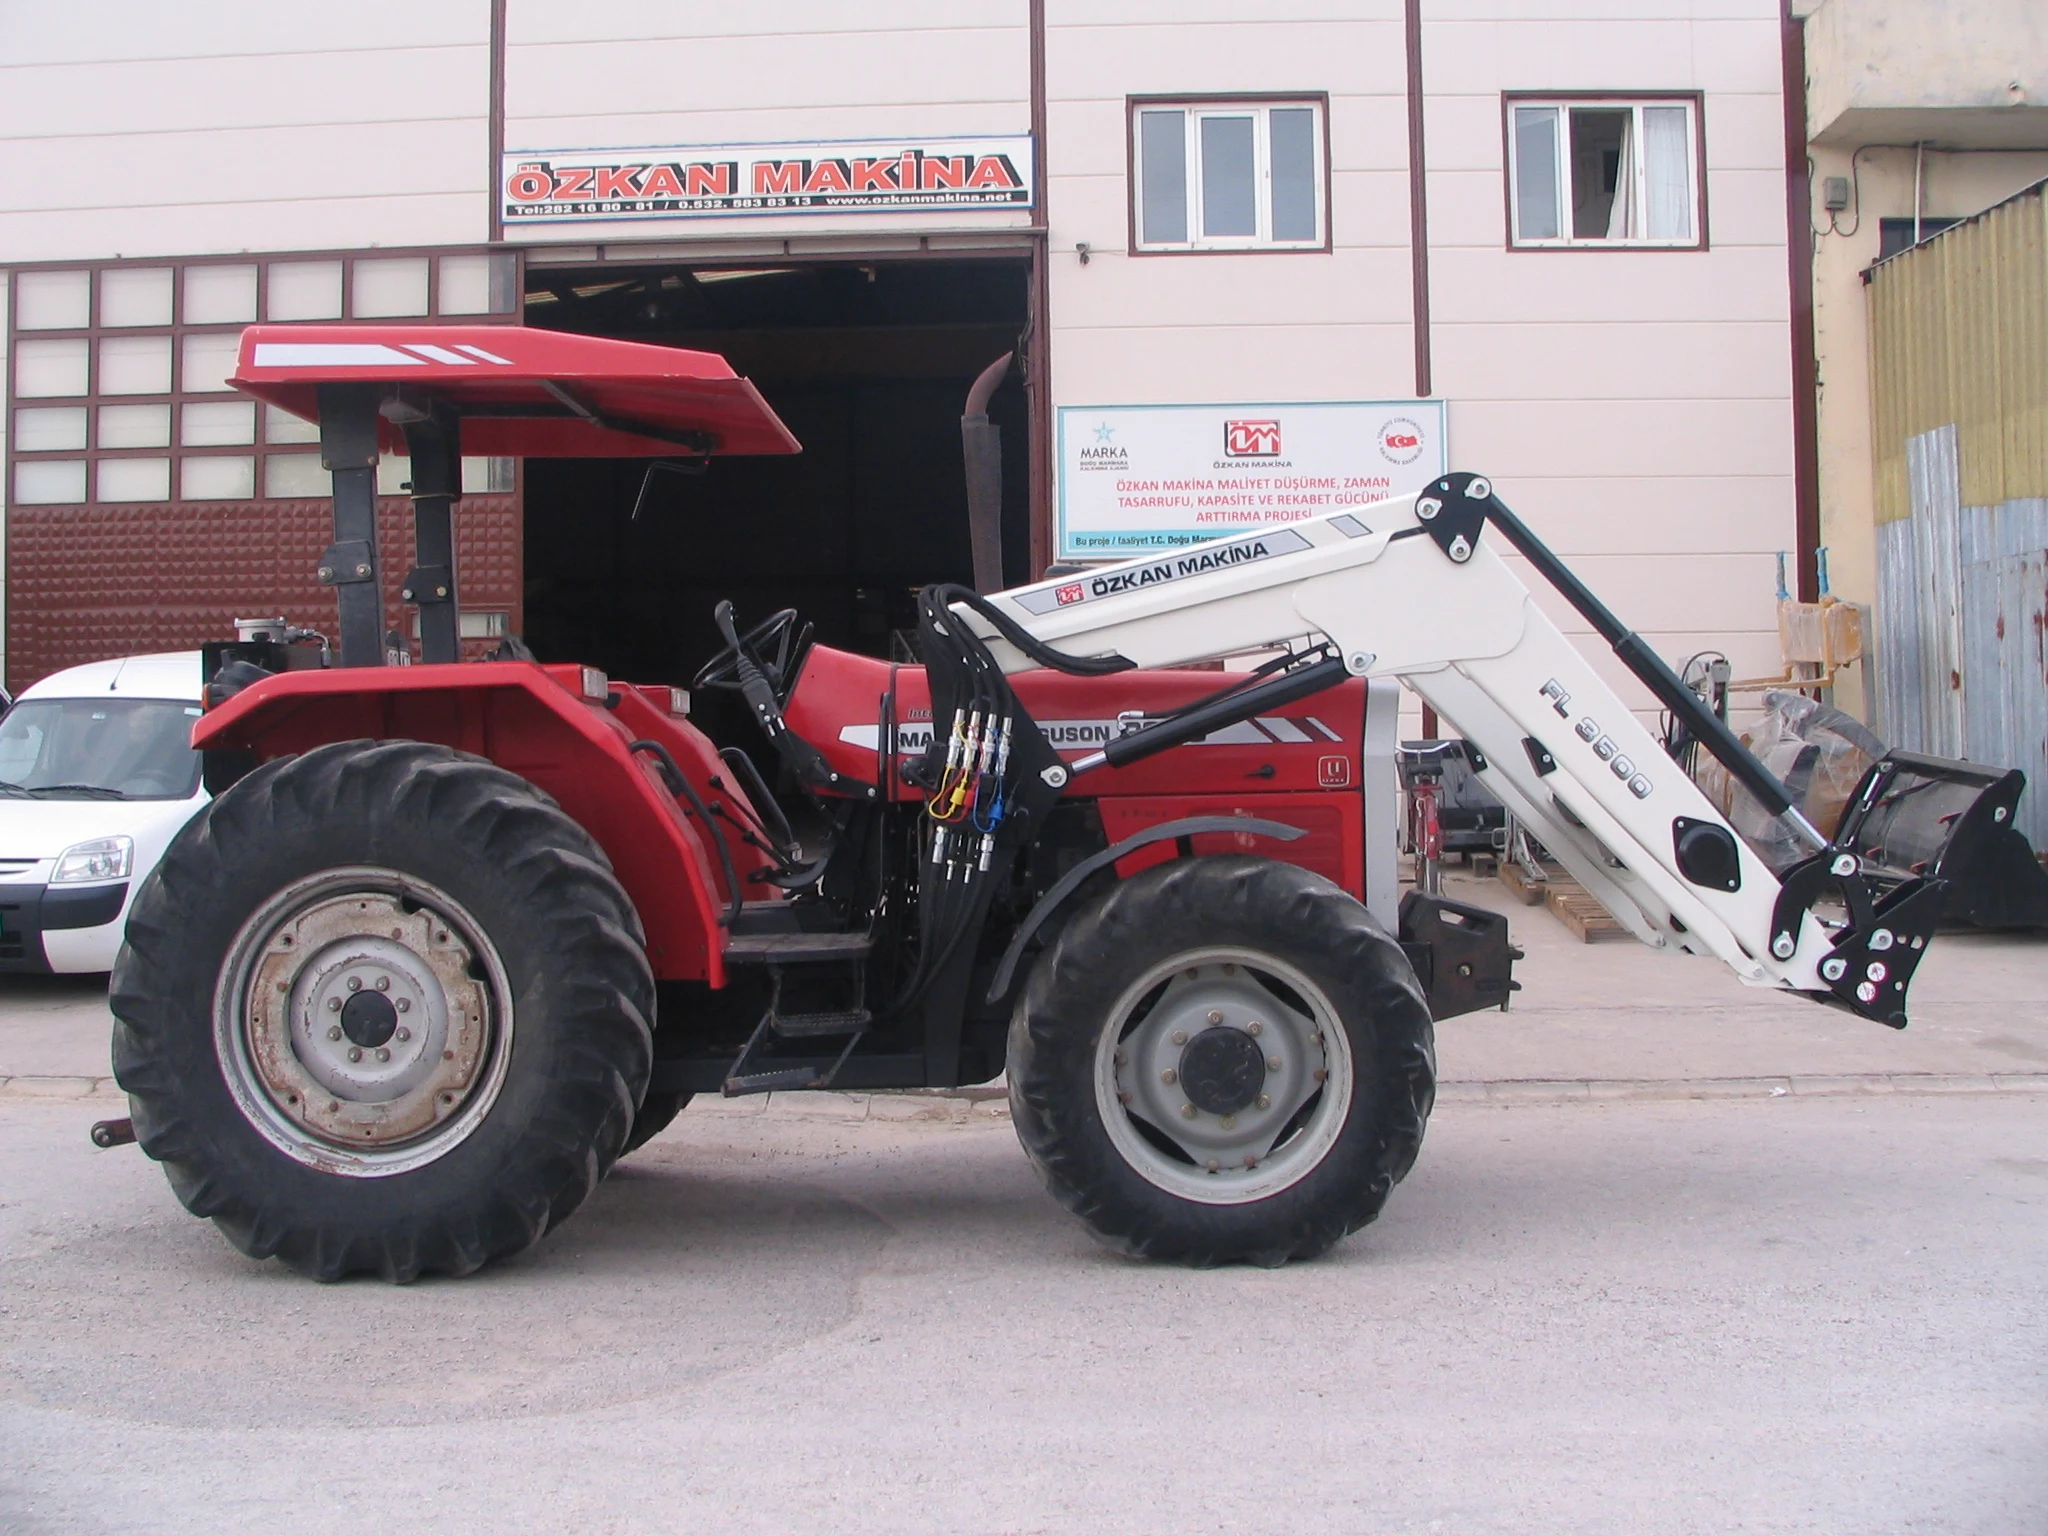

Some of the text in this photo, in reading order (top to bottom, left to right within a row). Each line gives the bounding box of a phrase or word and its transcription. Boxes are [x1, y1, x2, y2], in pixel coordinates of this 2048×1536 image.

[507, 150, 1024, 200] ÖZKAN MAKİNA
[825, 193, 1013, 205] www.ozkanmakina.net
[1080, 446, 1128, 459] MARKA
[1213, 459, 1292, 469] ÖZKAN MAKİNA
[1116, 475, 1390, 491] ÖZKAN MAKİNA MALİYET DÜŞÜRME, ZAMAN
[1118, 496, 1194, 508] TASARRUFU,
[1197, 493, 1255, 506] KAPASİTE
[1258, 495, 1274, 505] VE
[1277, 494, 1331, 505] REKABET
[1196, 508, 1312, 523] ARTTIRMA PROJESİ
[1075, 537, 1087, 546] Bu
[1089, 537, 1110, 547] proje
[1118, 535, 1149, 547] faaliyet
[1150, 535, 1165, 545] T.C.
[1168, 535, 1190, 546] Doğu
[1092, 541, 1269, 597] ÖZKAN MAKİNA
[1538, 677, 1654, 800] FL 3500
